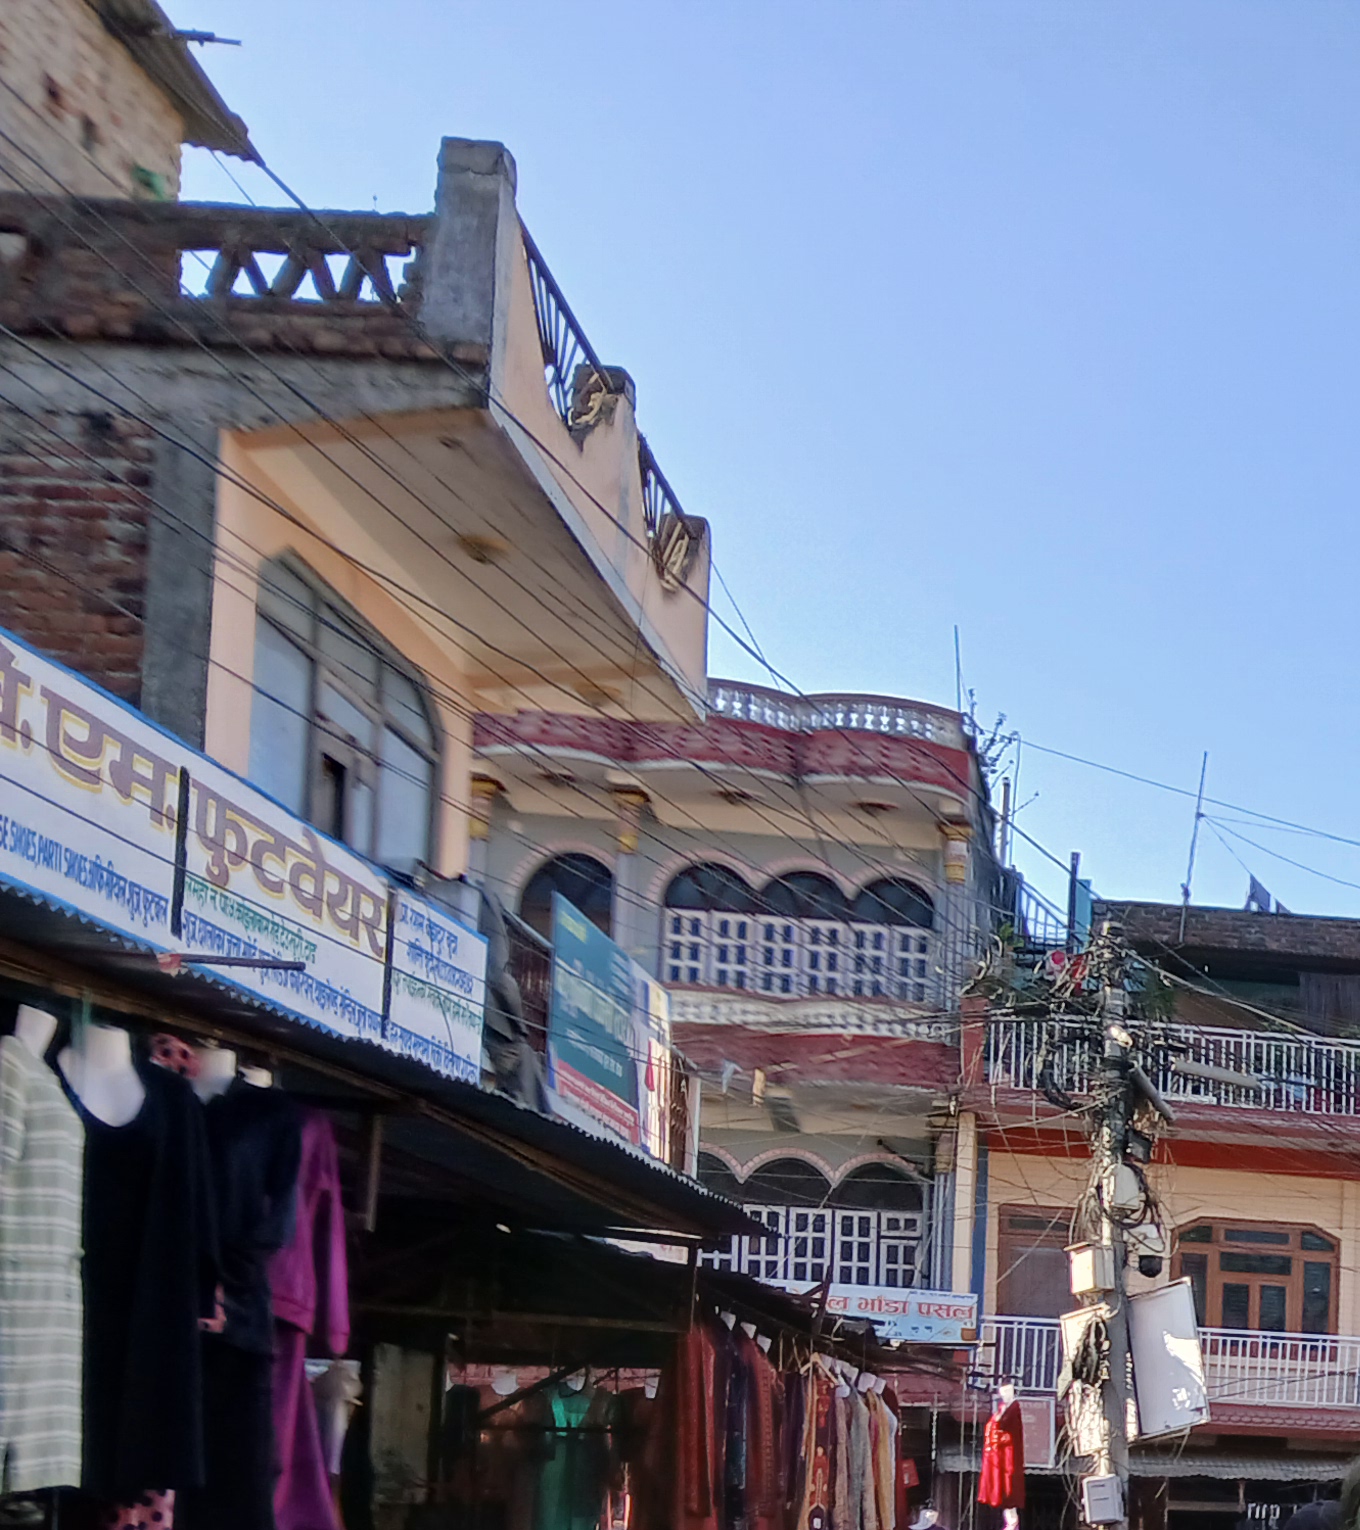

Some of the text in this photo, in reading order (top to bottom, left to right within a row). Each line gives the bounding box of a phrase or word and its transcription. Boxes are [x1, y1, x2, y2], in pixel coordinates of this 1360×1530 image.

[191, 777, 386, 958] फुटवेयर
[858, 1294, 909, 1315] भाँडा
[917, 1301, 974, 1320] पसल
